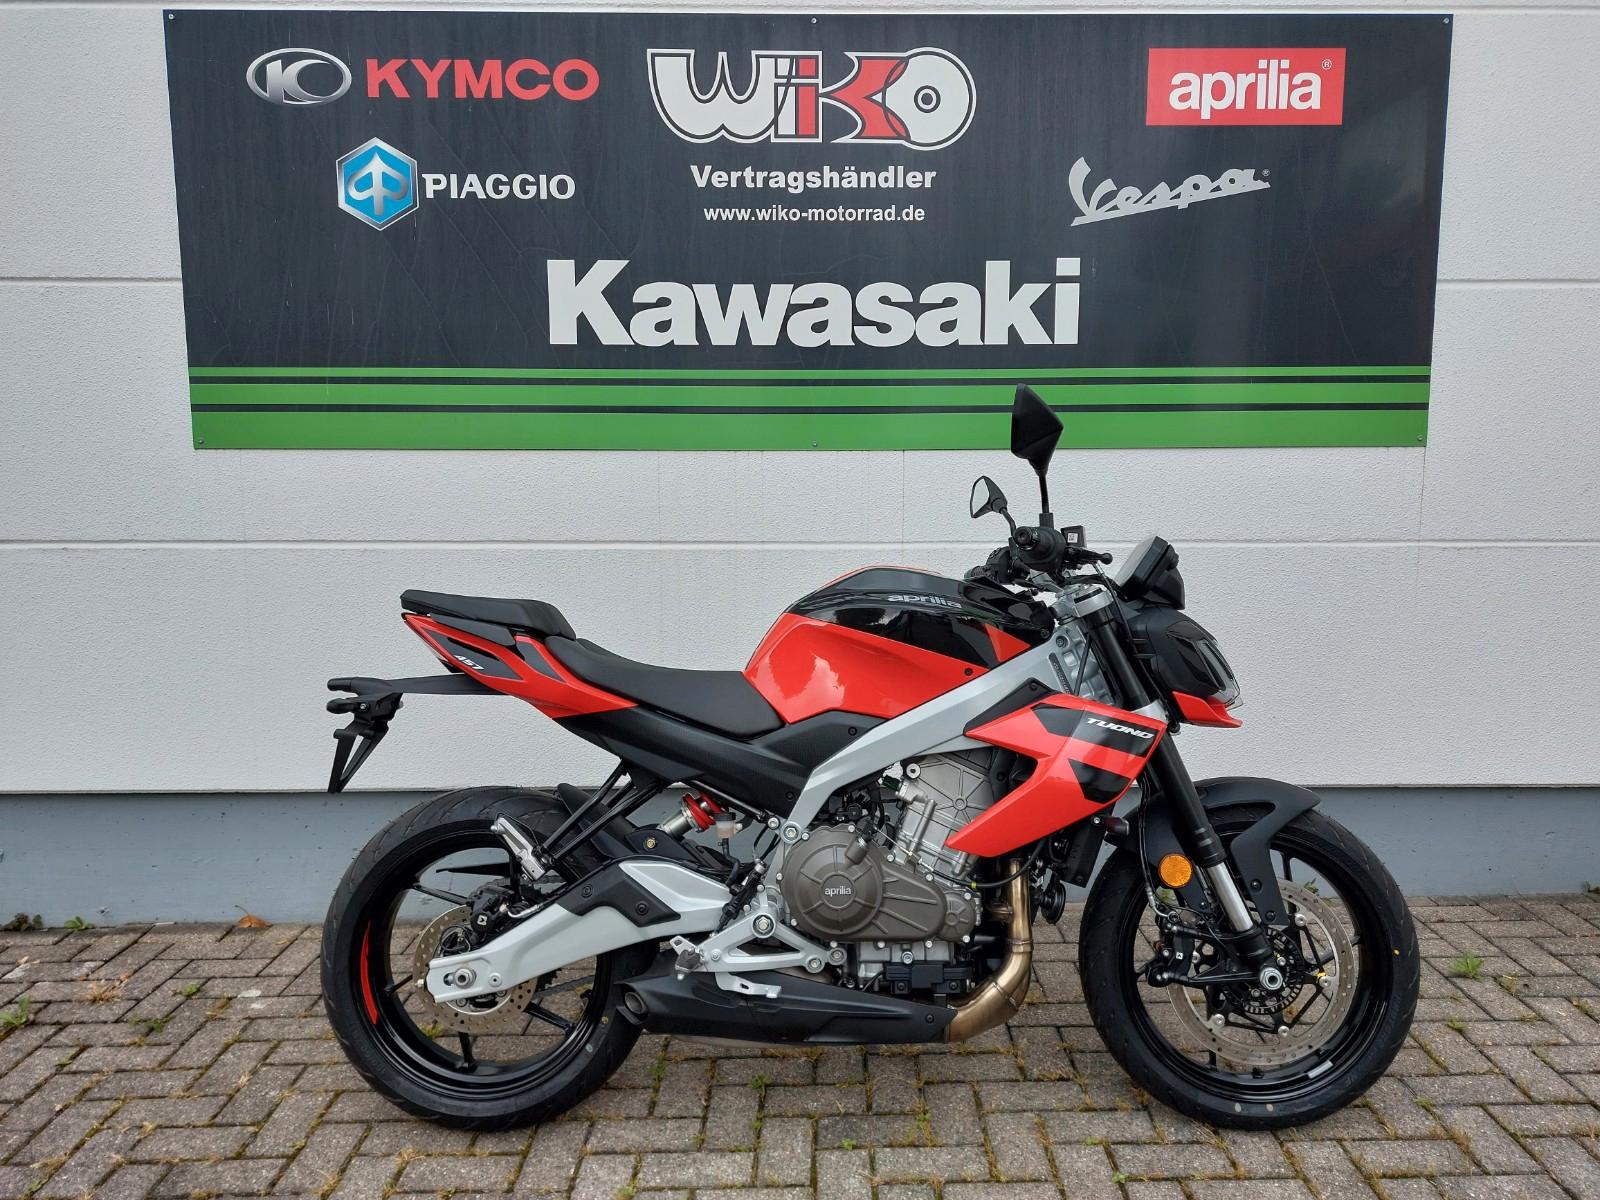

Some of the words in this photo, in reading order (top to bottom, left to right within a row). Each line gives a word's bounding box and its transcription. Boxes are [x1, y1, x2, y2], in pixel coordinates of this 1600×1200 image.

[366, 58, 600, 101] KYMCO
[422, 173, 576, 200] PIAGGIO
[690, 164, 937, 194] Vertragshändler
[1068, 156, 1271, 226] Vespa
[703, 204, 926, 222] www.wiko-motorrad.de
[546, 257, 1081, 348] Kawasaki
[887, 594, 962, 609] aprilia
[453, 654, 485, 670] 457
[1087, 717, 1154, 739] TUONO
[824, 885, 852, 897] aprilia
